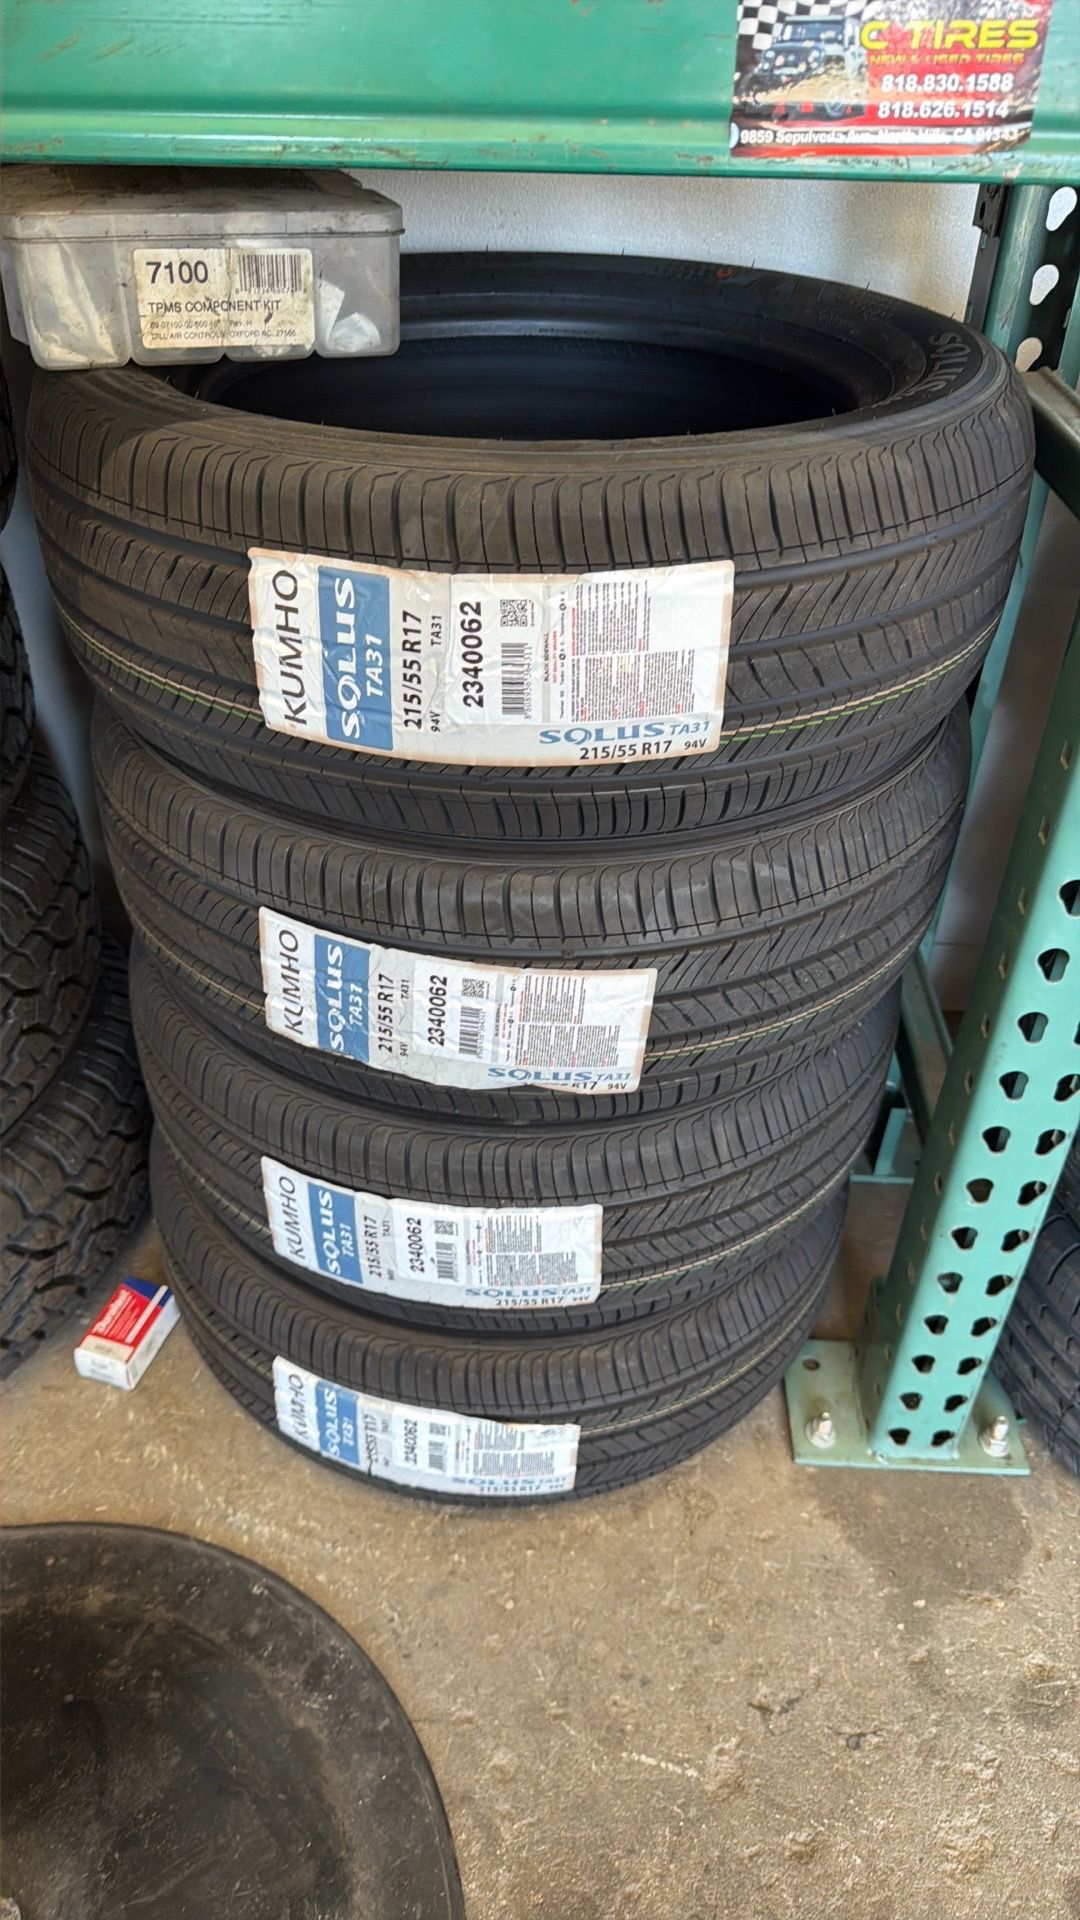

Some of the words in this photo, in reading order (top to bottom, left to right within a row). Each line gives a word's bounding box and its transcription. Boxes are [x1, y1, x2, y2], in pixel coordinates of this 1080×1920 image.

[861, 19, 890, 49] C
[905, 18, 1039, 49] TIRES
[869, 54, 906, 65] NEW
[925, 53, 971, 64] USED
[976, 53, 1024, 64] TIRES
[881, 72, 1014, 93] 818.830.1588
[877, 99, 1009, 119] 818.626.1514
[740, 129, 774, 144] 9859
[146, 260, 208, 284] 7100
[148, 301, 182, 313] TPMS
[185, 300, 261, 312] COMPONENT
[263, 299, 281, 310] KIT
[402, 610, 422, 653] R17
[431, 614, 442, 646] TA31
[272, 570, 307, 725] KUMHO
[335, 577, 361, 739] SOLUS
[460, 601, 484, 708] 2340062
[365, 634, 384, 698] TA31
[402, 660, 422, 730] 215/55
[431, 711, 441, 732] 94V
[539, 722, 665, 745] SOLUS
[669, 721, 710, 736] TA31
[580, 744, 637, 760] 215/55
[642, 740, 672, 755] R17
[684, 738, 707, 750] 94V
[279, 929, 304, 1035] KUMHO
[327, 944, 345, 1051] SOLUS
[378, 973, 394, 1003] R17
[401, 979, 410, 1000] TA31
[349, 983, 363, 1026] TA31
[428, 974, 447, 1047] 2340062
[378, 1004, 394, 1053] 215/55
[488, 1068, 592, 1081] SOLUS
[597, 1072, 631, 1082] TA31
[608, 1082, 627, 1090] 94V
[279, 1176, 305, 1260] KUMHO
[320, 1189, 340, 1275] SOLUS
[364, 1215, 377, 1239] R17
[365, 1239, 382, 1278] 215/55
[407, 1217, 424, 1273] 2340062
[465, 1288, 557, 1298] SOLUS
[562, 1286, 591, 1295] TA31
[496, 1298, 537, 1306] 215/55
[324, 1388, 341, 1457] SOLUS
